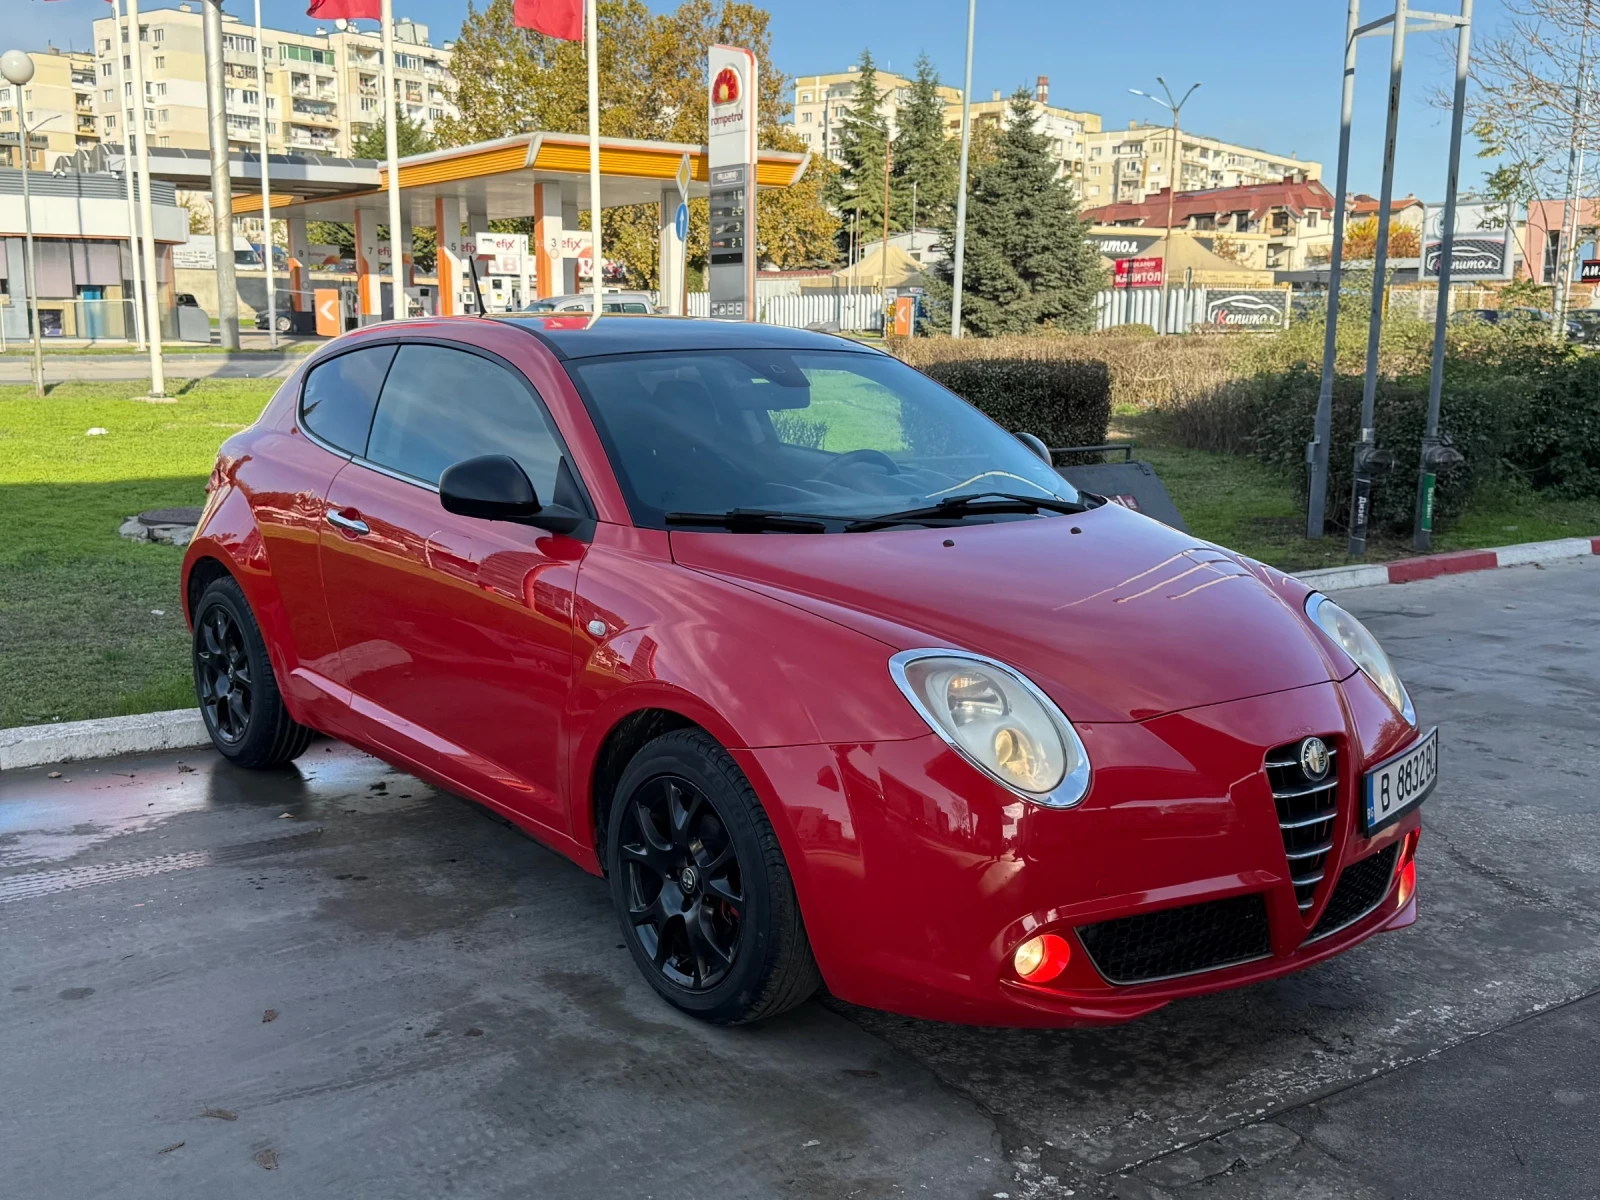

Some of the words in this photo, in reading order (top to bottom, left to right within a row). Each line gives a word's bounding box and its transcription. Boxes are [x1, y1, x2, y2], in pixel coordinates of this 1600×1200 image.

[711, 109, 744, 128] rompetrol
[451, 242, 457, 251] 5
[496, 239, 516, 251] efix
[522, 240, 527, 252] 1
[551, 238, 557, 247] 3
[562, 237, 583, 251] efix
[298, 249, 304, 258] 9
[368, 246, 374, 255] 7
[1115, 271, 1161, 283] КАПИТОЛ
[1380, 773, 1390, 813] B
[1396, 754, 1425, 801] 8832
